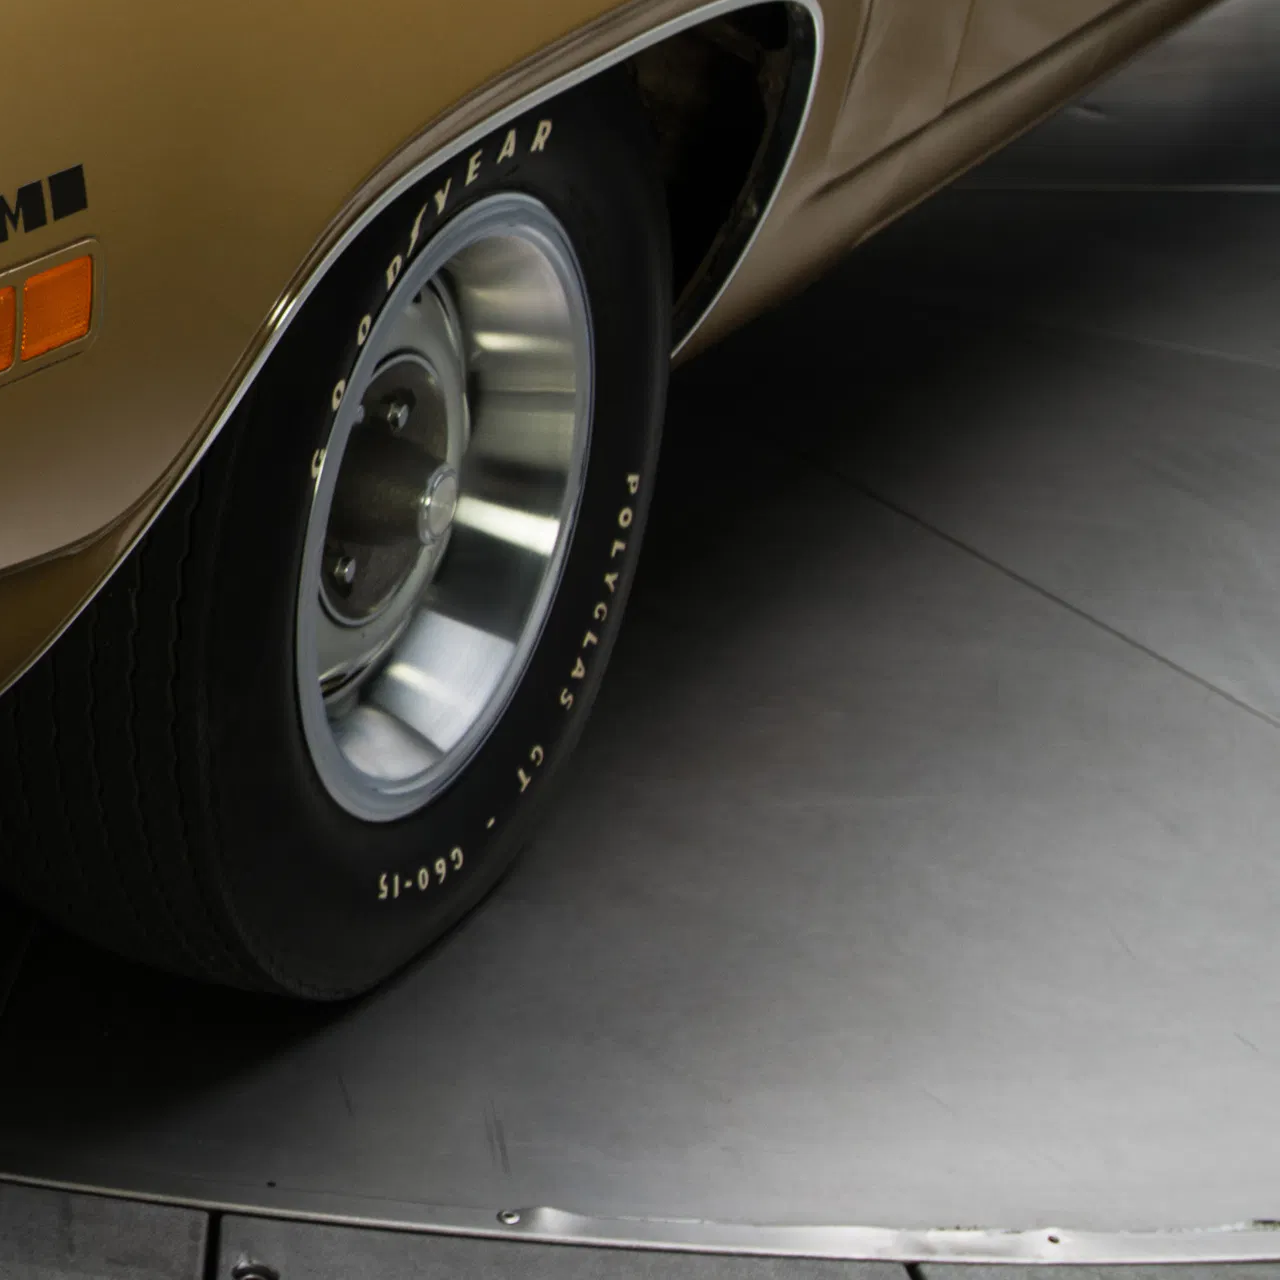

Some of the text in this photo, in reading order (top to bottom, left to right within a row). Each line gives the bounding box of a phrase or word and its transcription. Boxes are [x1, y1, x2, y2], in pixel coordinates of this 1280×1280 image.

[559, 473, 640, 710] POLYGLAS
[517, 745, 544, 792] GT
[378, 847, 464, 900] G60-15
